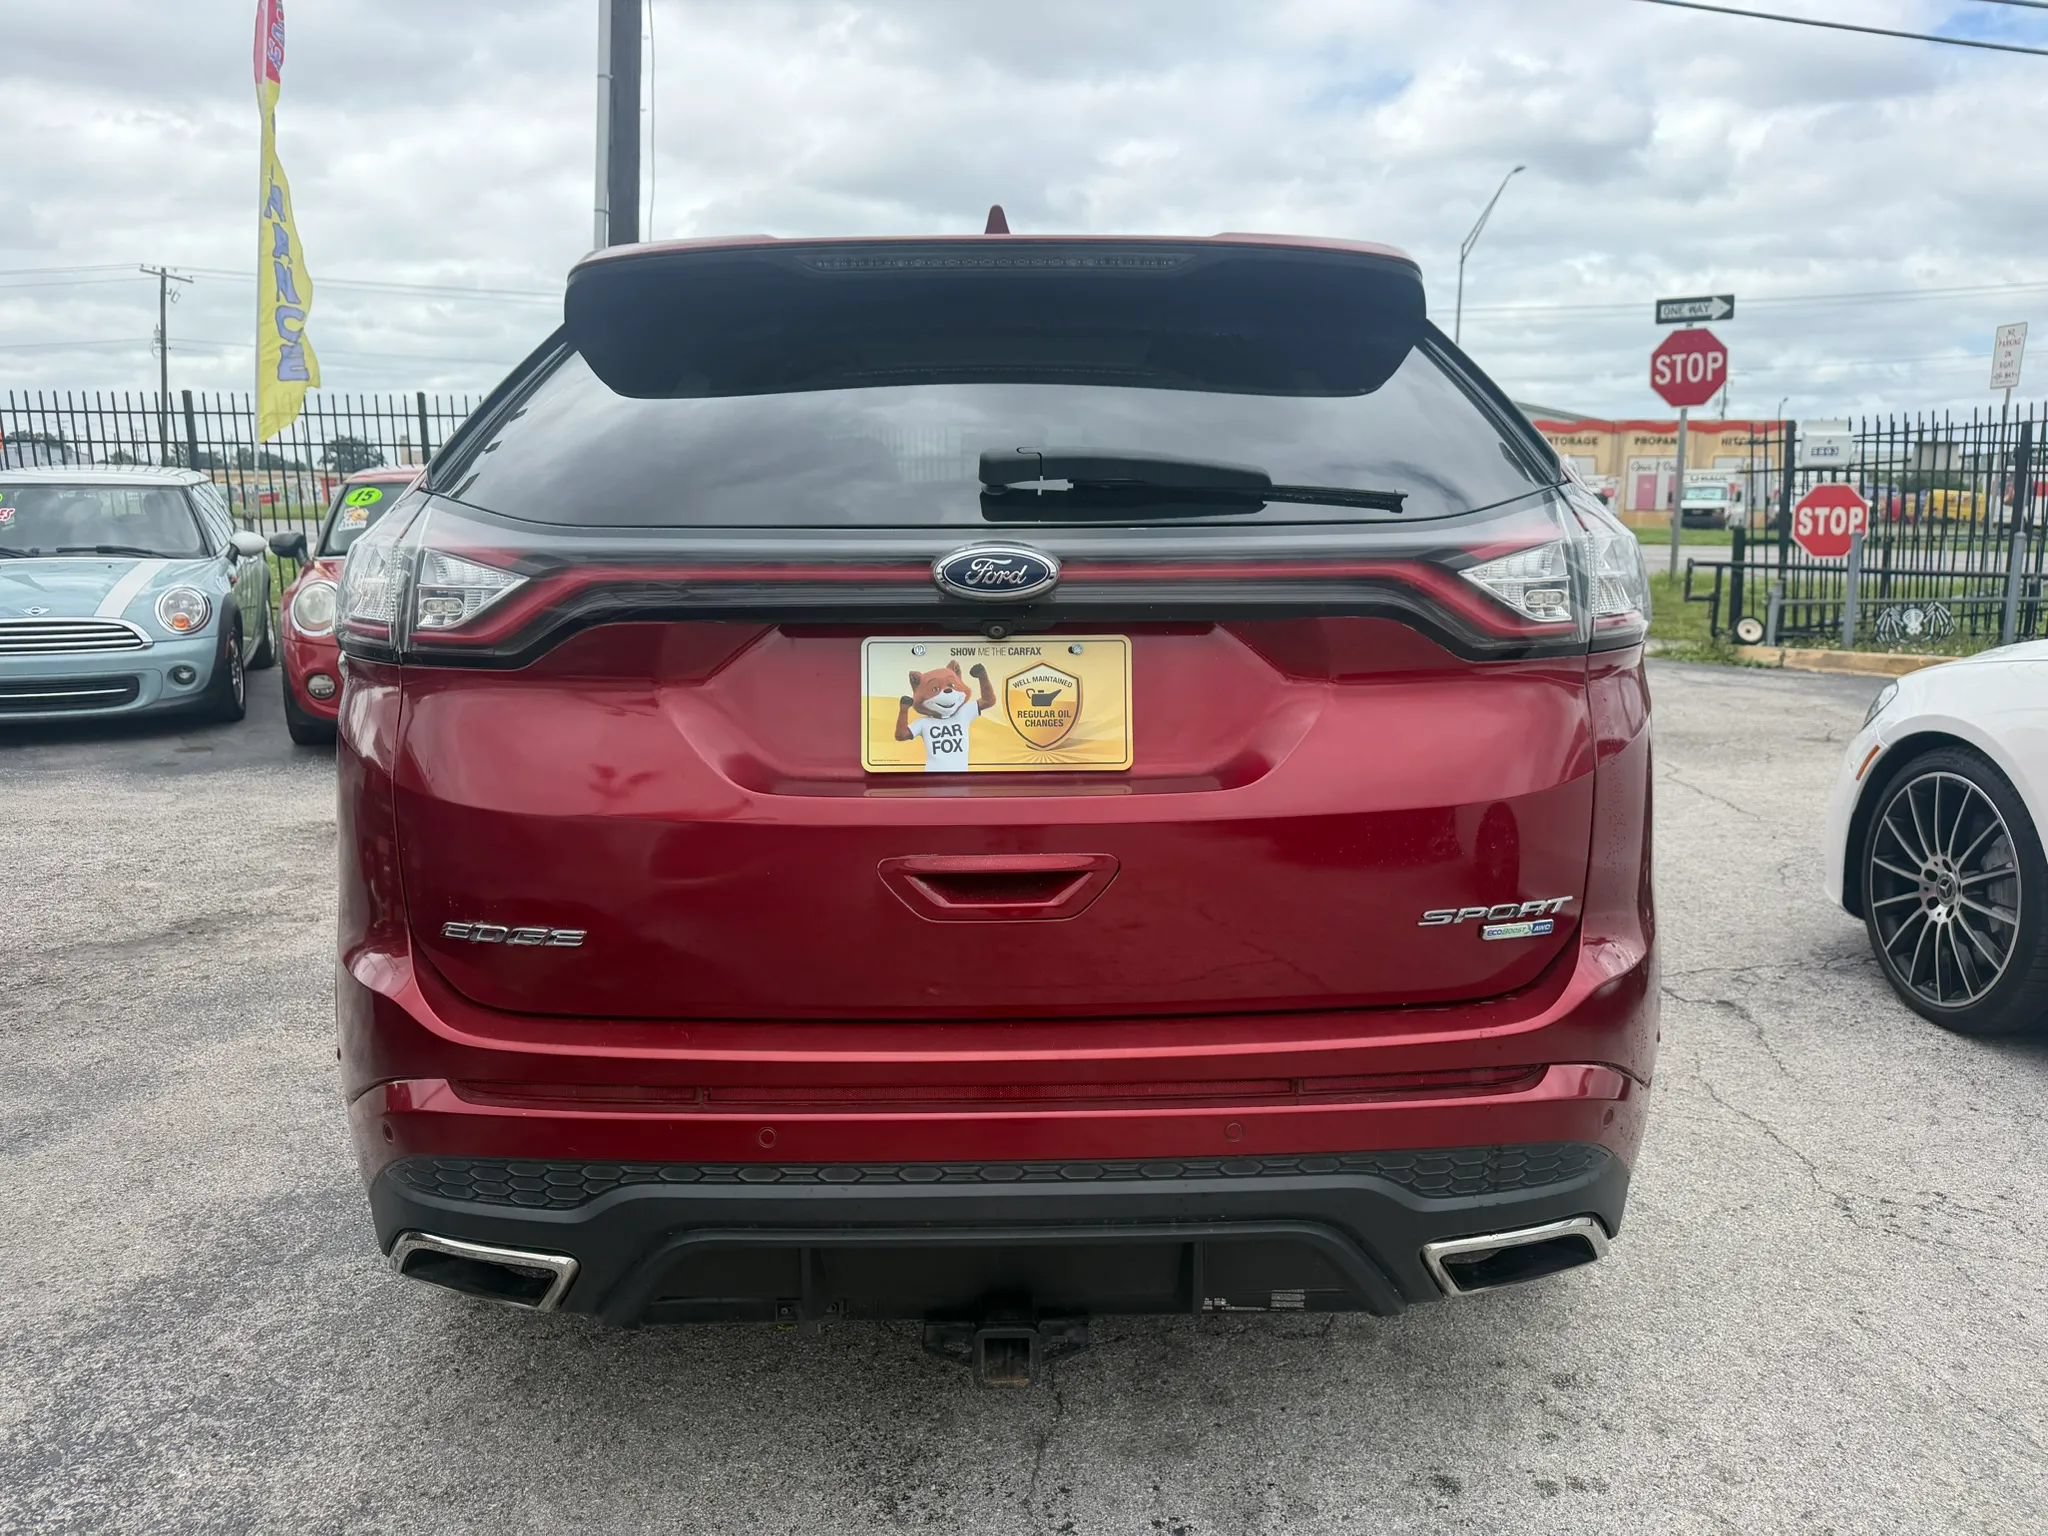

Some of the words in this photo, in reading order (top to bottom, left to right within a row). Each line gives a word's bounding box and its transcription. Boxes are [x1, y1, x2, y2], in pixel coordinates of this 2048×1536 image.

[1663, 304, 1683, 316] ONE
[1688, 302, 1710, 314] WAY
[1654, 351, 1724, 385] STOP
[1634, 436, 1678, 446] PROPAN
[352, 490, 375, 502] 15
[1798, 506, 1864, 536] STOP
[964, 558, 1027, 585] Ford
[950, 647, 976, 656] SHOW
[978, 647, 990, 656] ME
[992, 647, 1006, 656] THE
[1008, 647, 1042, 656] CARFAX
[1012, 678, 1031, 688] WELL
[1032, 675, 1073, 688] MAINTAINED
[1017, 710, 1056, 718] REGULAR
[1058, 709, 1072, 718] OIL
[1025, 719, 1064, 727] CHANGES
[929, 723, 963, 738] CAR
[932, 738, 963, 754] FOX
[1418, 895, 1573, 926] SPORT
[441, 921, 588, 946] EDGE
[1533, 923, 1551, 932] AWD
